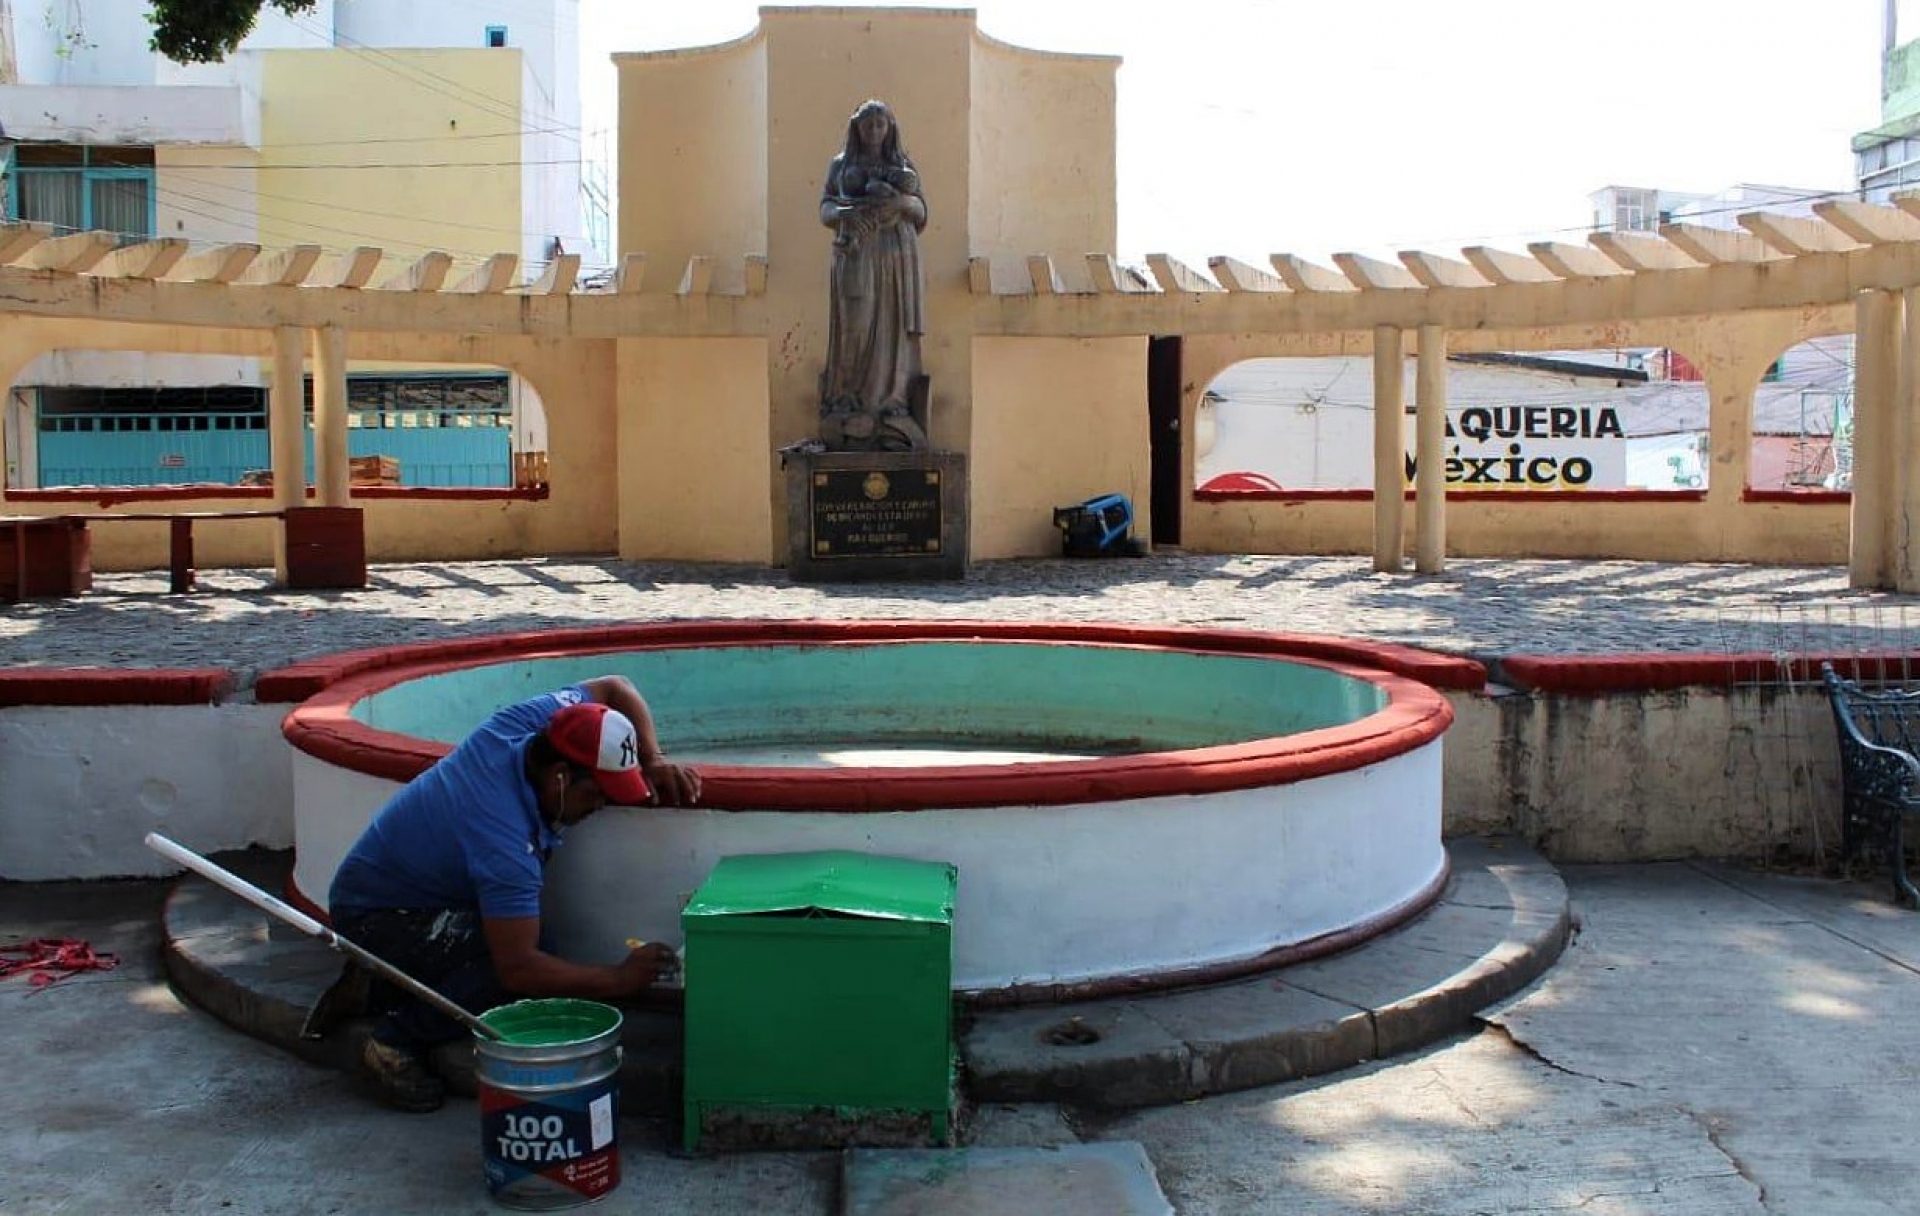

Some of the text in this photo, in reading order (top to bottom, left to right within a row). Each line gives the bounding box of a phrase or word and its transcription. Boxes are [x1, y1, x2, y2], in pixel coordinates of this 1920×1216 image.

[1405, 406, 1624, 443] QUERIA
[505, 1113, 563, 1139] 100
[497, 1136, 582, 1161] TOTAL
